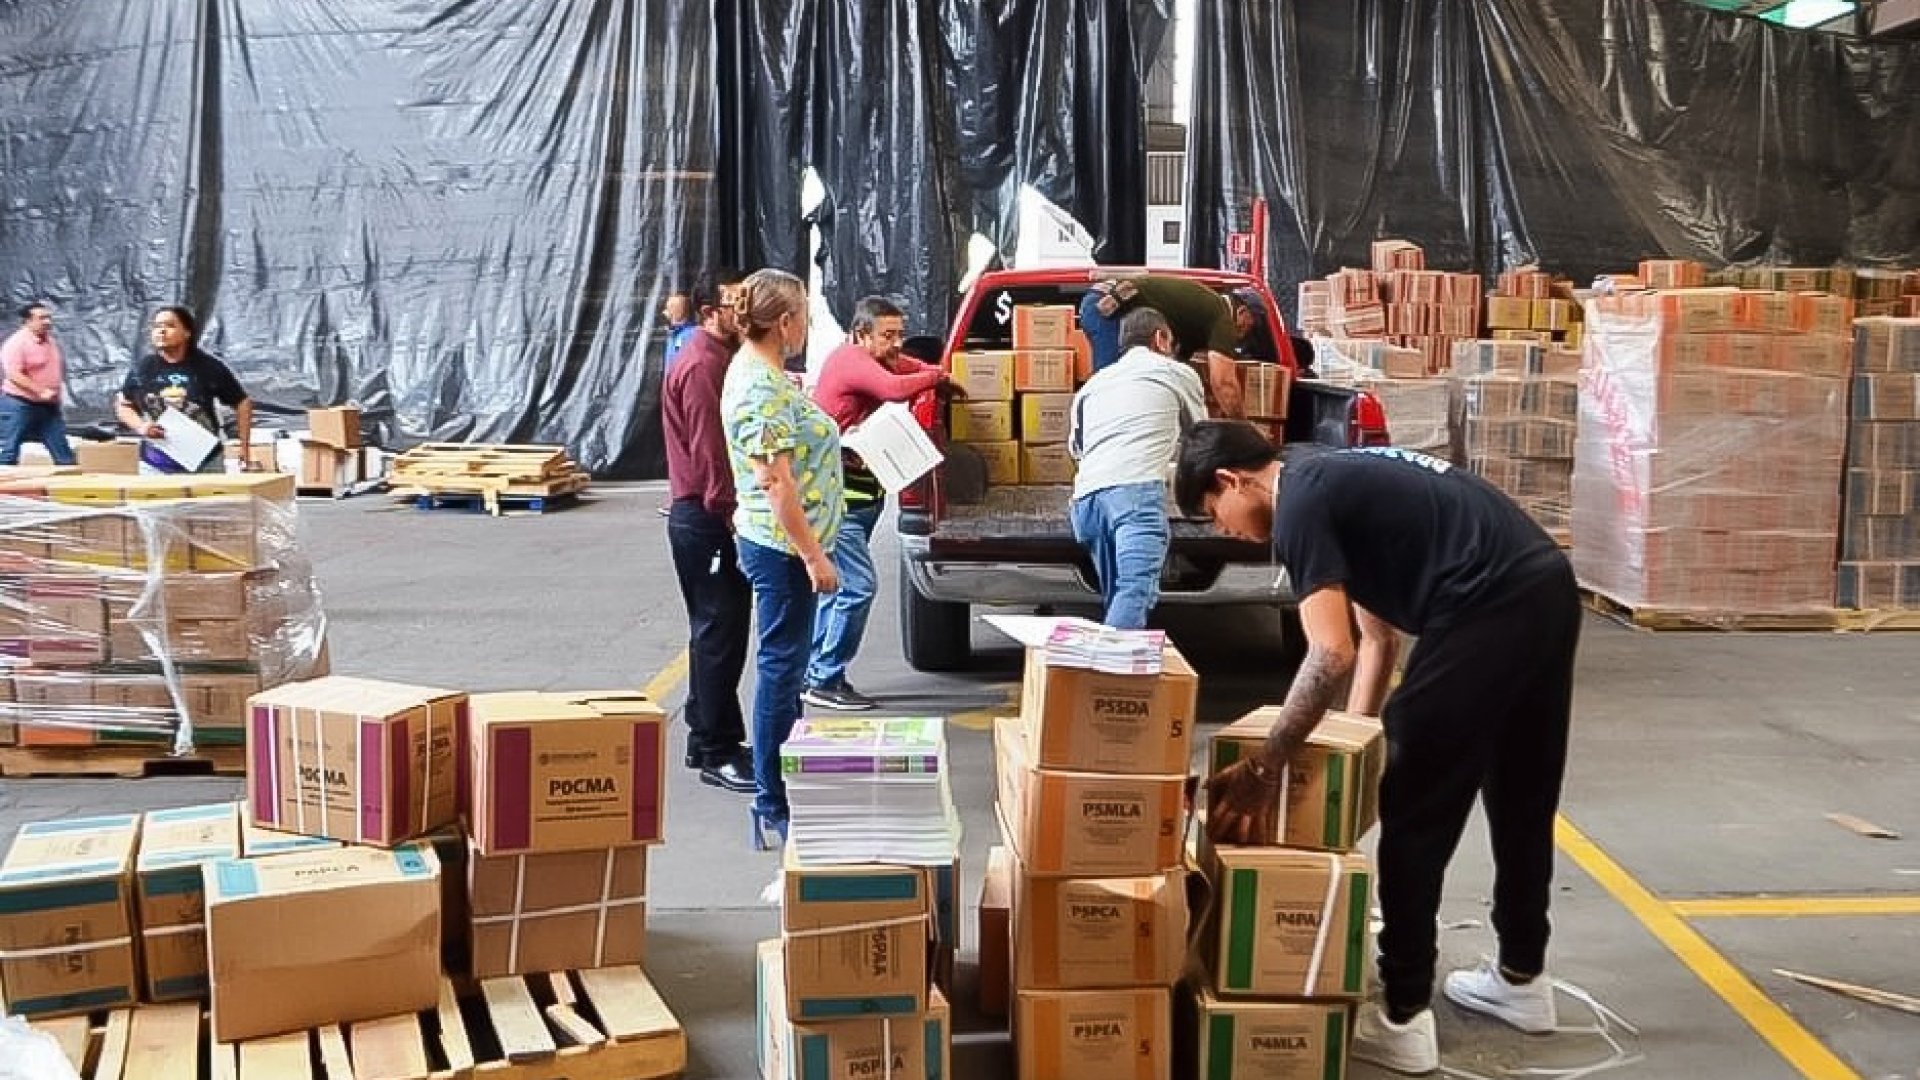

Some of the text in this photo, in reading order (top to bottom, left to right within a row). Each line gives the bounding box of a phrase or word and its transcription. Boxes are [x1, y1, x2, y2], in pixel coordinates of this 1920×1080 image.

[1170, 720, 1183, 738] 5
[1083, 803, 1141, 817] P5MLA
[1160, 819, 1176, 836] 5
[1252, 1036, 1307, 1050] P4MLA
